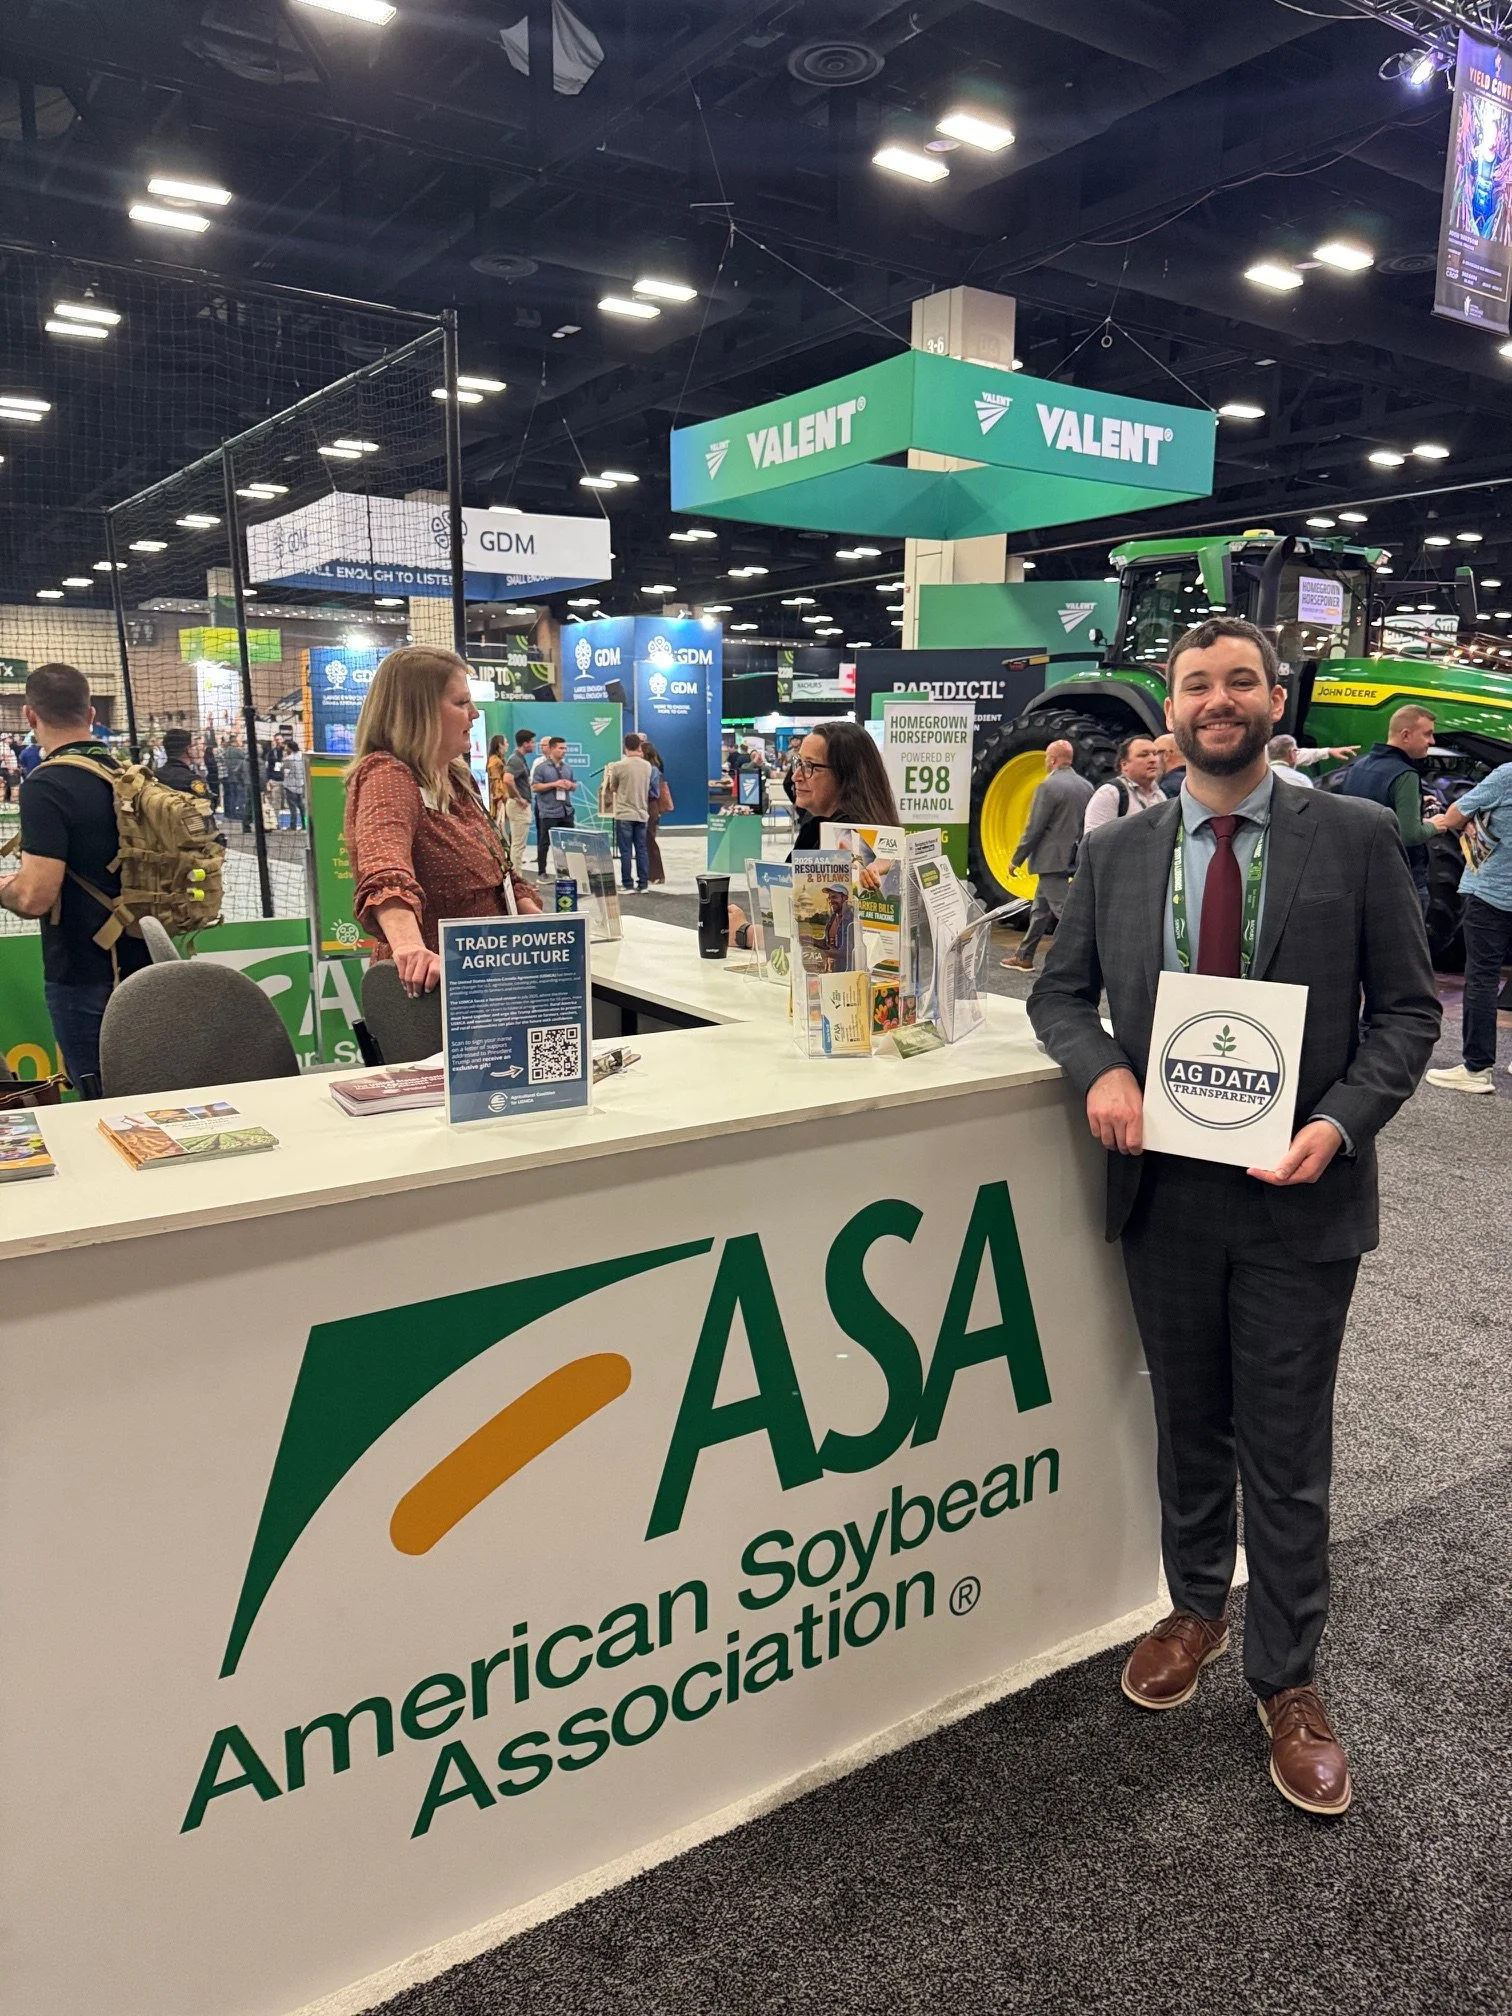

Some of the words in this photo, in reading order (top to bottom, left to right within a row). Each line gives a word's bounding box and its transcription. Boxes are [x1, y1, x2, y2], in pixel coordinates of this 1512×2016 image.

[1469, 67, 1491, 89] YIELD
[1491, 78, 1512, 102] CONT
[982, 391, 1013, 407] VALENT
[480, 530, 536, 555] GDM
[336, 566, 394, 583] ENOUGH
[395, 571, 414, 583] TO
[1302, 581, 1341, 596] HOMEGROWN
[1065, 602, 1098, 610] VALENT
[1302, 593, 1340, 607] HORSEPOWER
[594, 646, 622, 668] GDM
[677, 648, 713, 666] GDM
[352, 668, 377, 683] GD
[500, 690, 536, 701] Experien
[670, 681, 698, 695] GDM
[1317, 687, 1344, 697] JOHN
[1344, 688, 1378, 699] DEERE
[890, 715, 968, 730] HOMEGROWN
[974, 714, 1003, 722] EDIENT
[890, 731, 967, 745] HORSEPOWER
[901, 752, 942, 763] POWERED
[945, 752, 956, 763] BY
[904, 765, 951, 794] E98
[900, 798, 954, 811] ETHANOL
[886, 838, 897, 848] ASA
[794, 864, 850, 874] RESOLUTIONS
[807, 873, 814, 882] &
[816, 873, 850, 883] BYLAWS
[878, 902, 895, 915] BILLS
[455, 934, 508, 952] TRADE
[512, 931, 576, 948] POWERS
[461, 949, 570, 970] AGRICULTURE
[484, 1037, 496, 1046] your
[452, 1064, 479, 1072] exclusive
[1170, 1062, 1203, 1083] AG
[1209, 1068, 1271, 1093] DATA
[1173, 1084, 1266, 1106] TRANSPARENT
[643, 1180, 1053, 1541] ASA
[178, 1576, 712, 1835] American
[736, 1446, 1061, 1611] Soybean
[409, 1568, 938, 1840] Association
